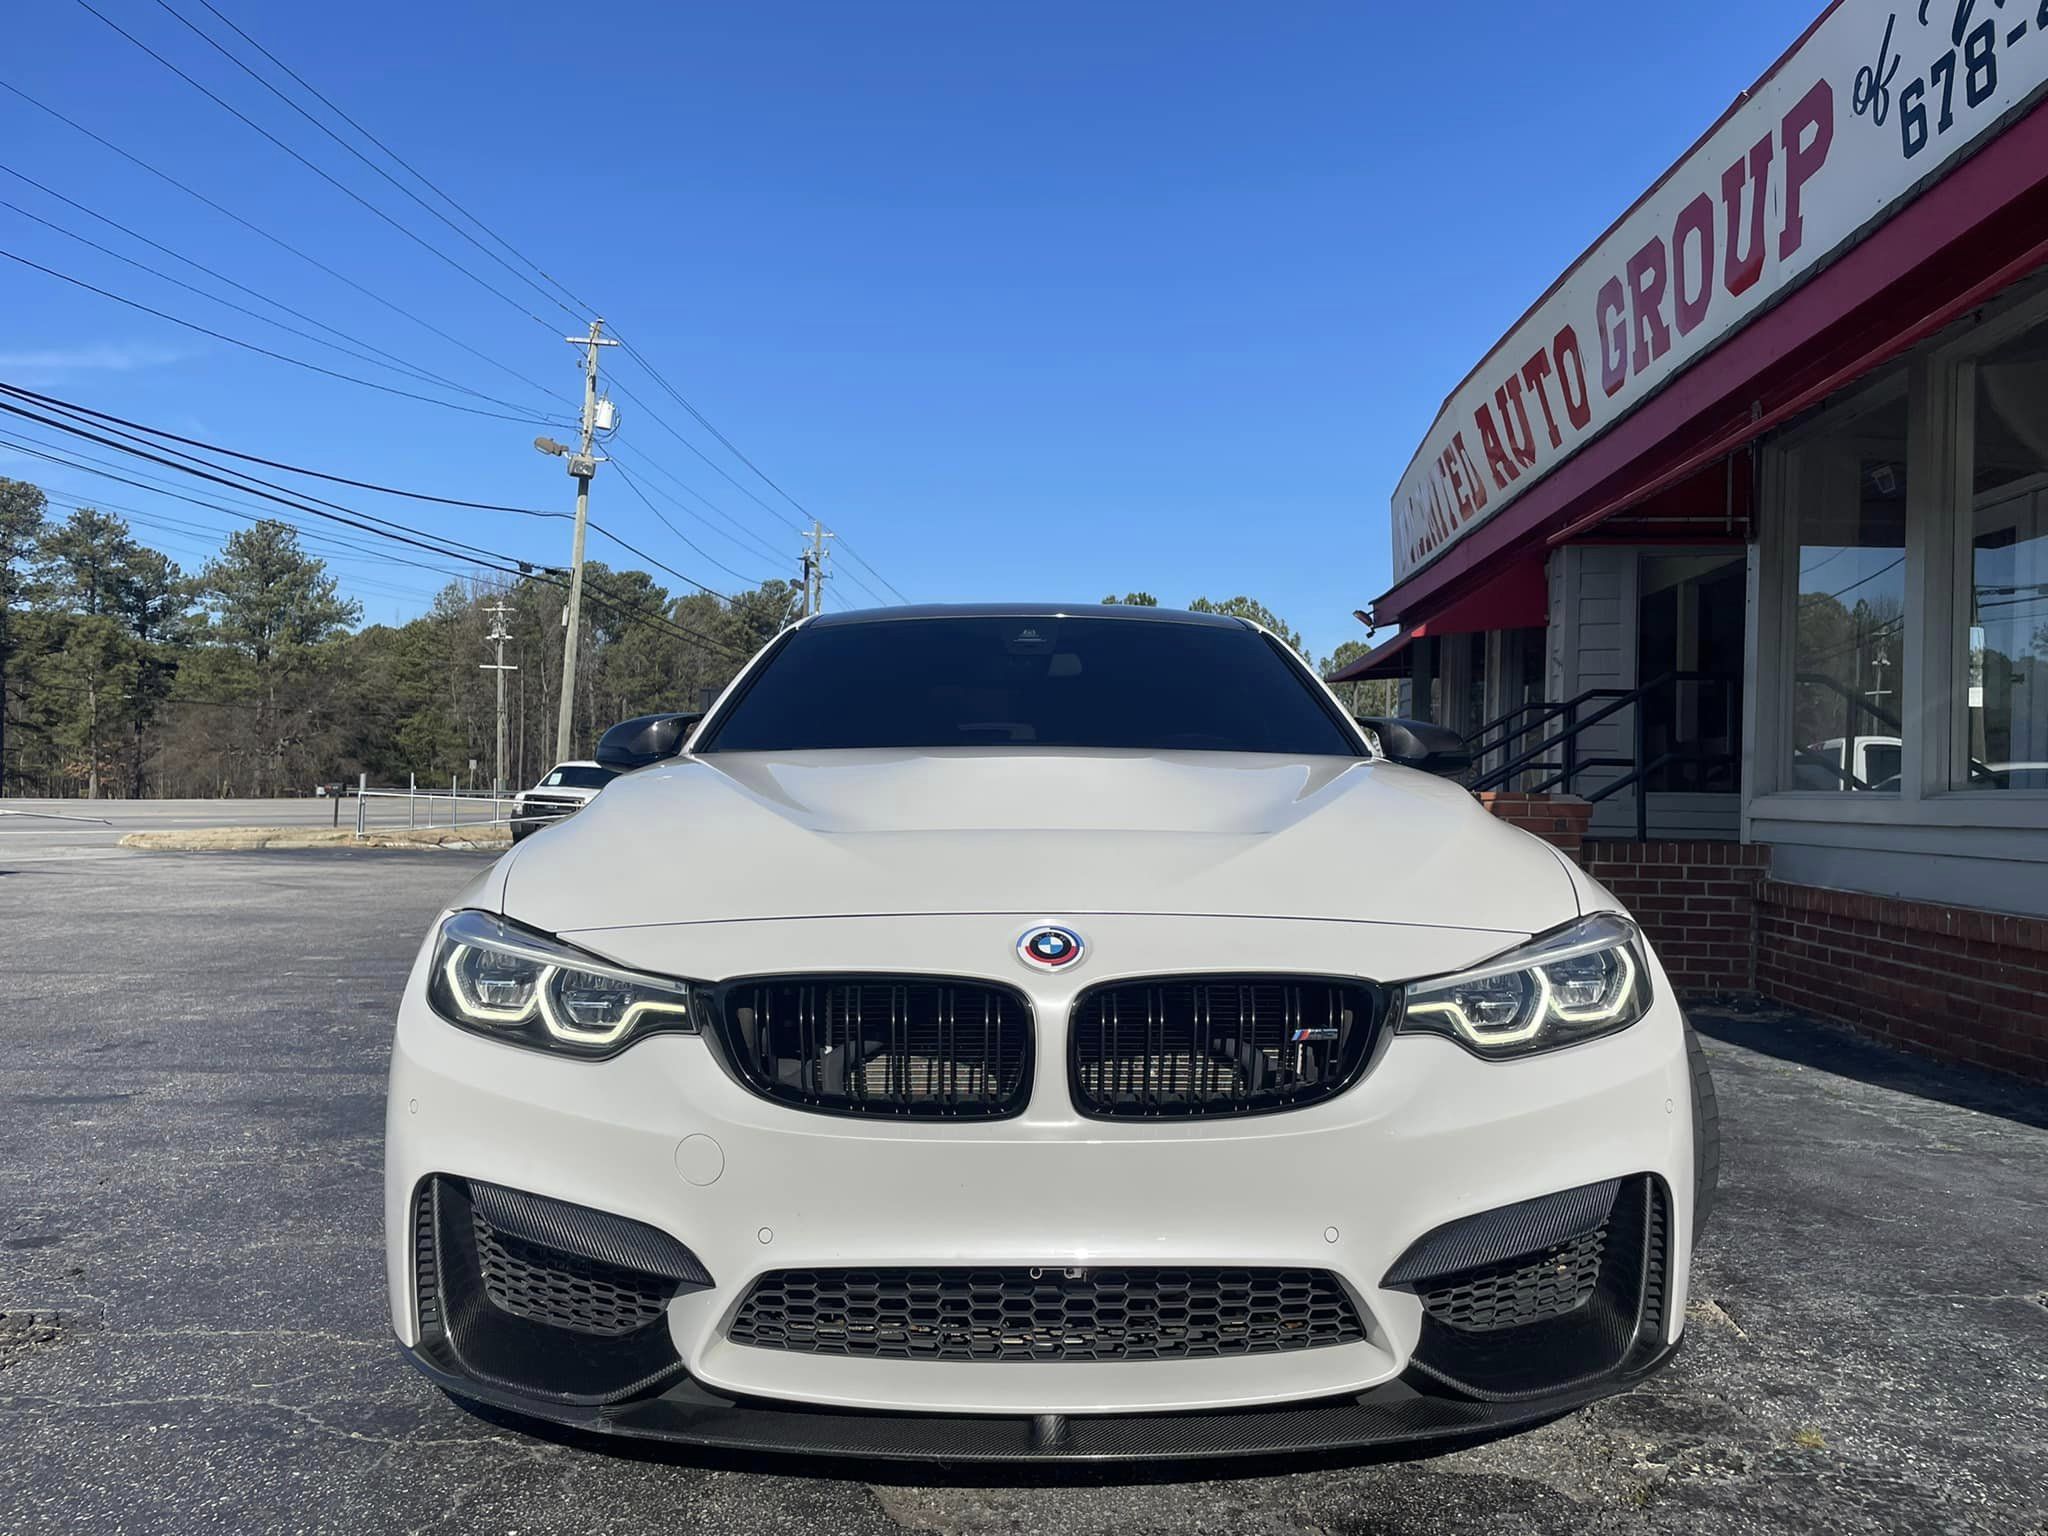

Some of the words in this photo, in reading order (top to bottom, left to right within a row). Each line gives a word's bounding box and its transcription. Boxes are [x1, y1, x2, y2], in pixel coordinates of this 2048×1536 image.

[1853, 13, 1901, 127] of
[1899, 0, 2048, 160] 678-
[1474, 323, 1592, 491] AUTO
[1596, 77, 1834, 398] GROUP
